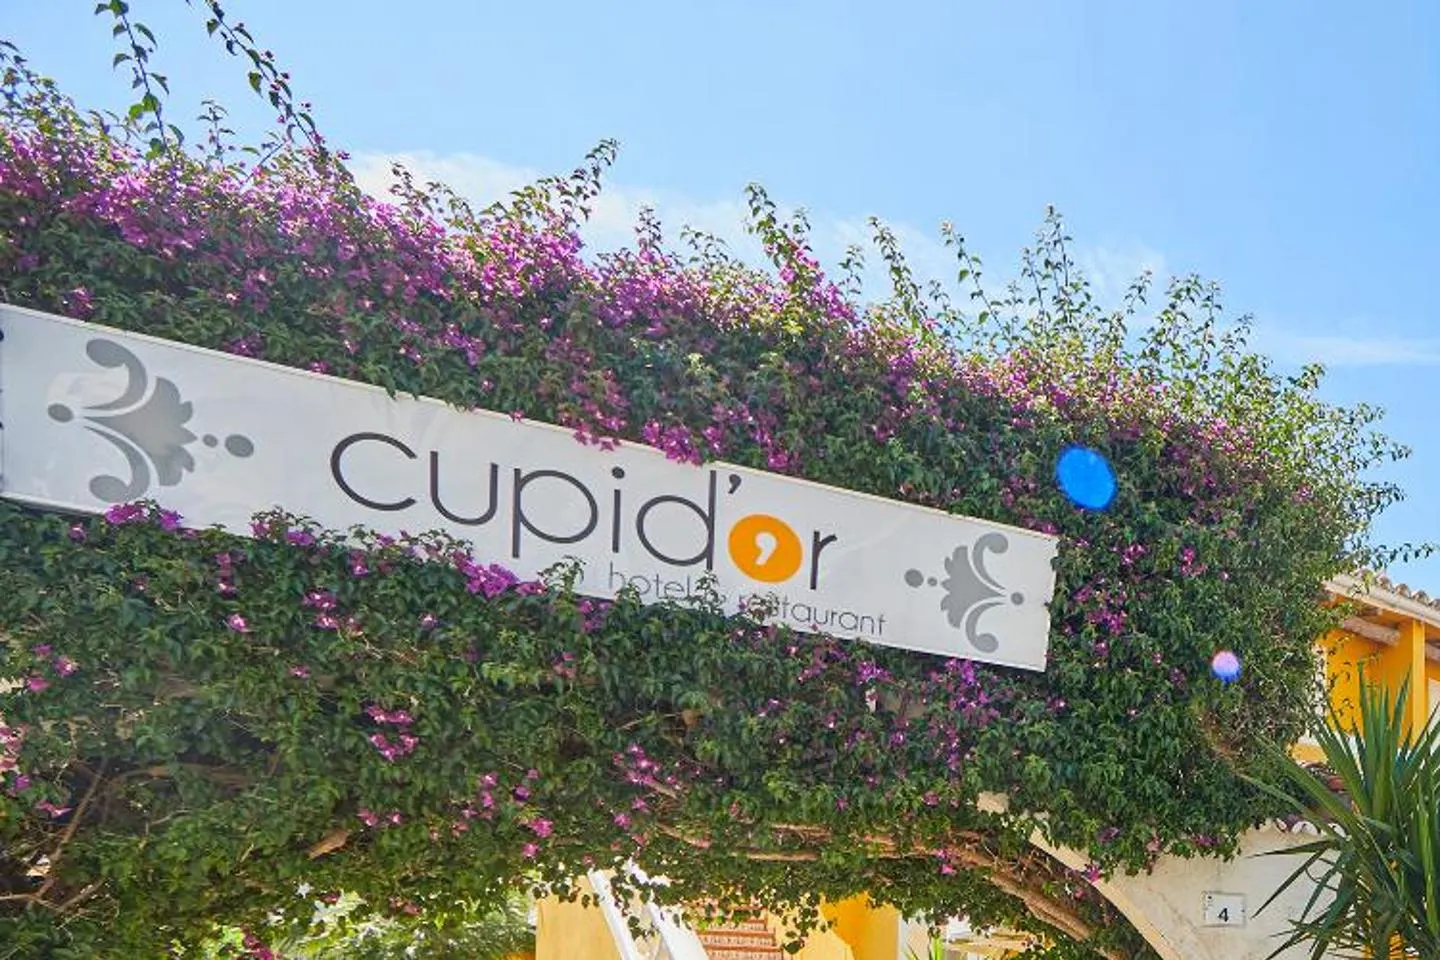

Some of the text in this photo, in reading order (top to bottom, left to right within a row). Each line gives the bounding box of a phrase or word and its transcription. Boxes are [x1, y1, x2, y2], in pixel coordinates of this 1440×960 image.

[608, 560, 691, 600] hotel
[738, 592, 888, 635] taurant
[1218, 908, 1229, 922] 4
